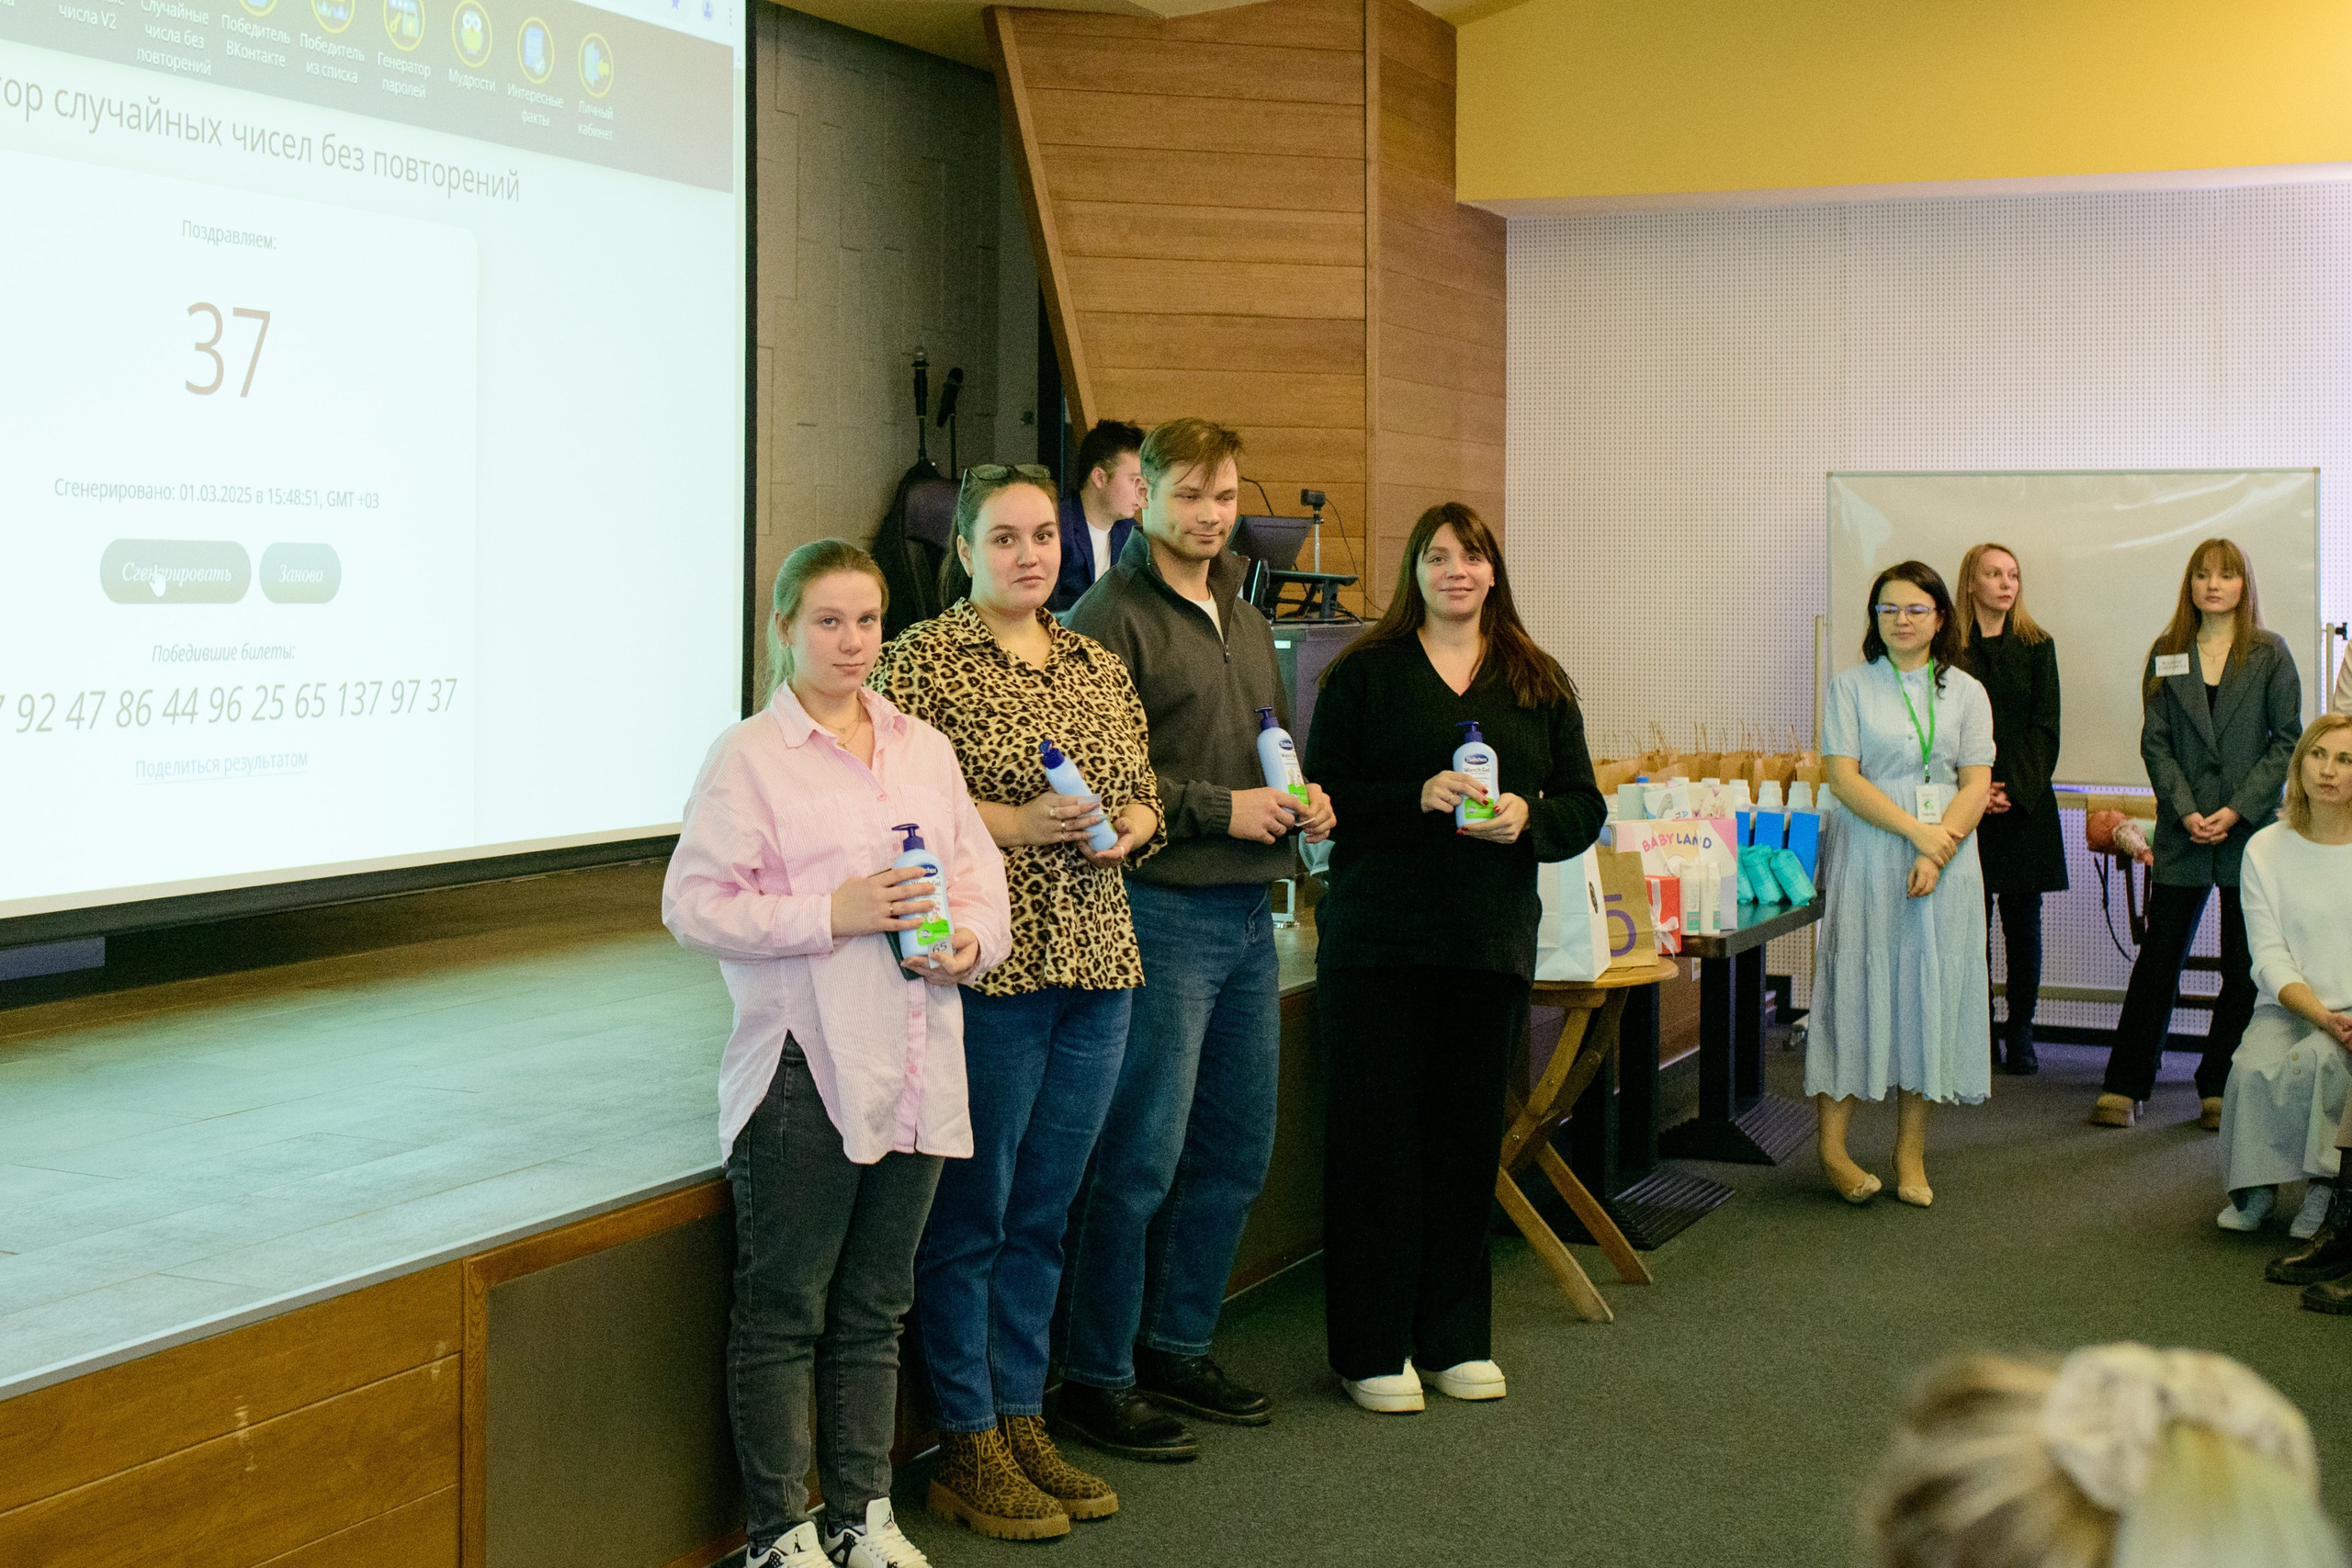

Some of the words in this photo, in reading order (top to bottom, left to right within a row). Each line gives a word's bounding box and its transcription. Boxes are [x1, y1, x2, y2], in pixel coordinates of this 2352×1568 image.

[59, 5, 98, 26] числа
[100, 10, 117, 29] V2
[221, 14, 291, 45] Победитель
[144, 24, 181, 44] числа
[184, 30, 205, 50] без
[300, 33, 366, 62] Победитель
[137, 48, 211, 75] повторений
[226, 39, 287, 68] ВКонтакте
[377, 51, 432, 80] Генератор
[306, 62, 320, 75] из
[322, 64, 358, 85] списка
[448, 68, 496, 93] Мудрости
[382, 78, 426, 100] паролей
[507, 83, 565, 109] Интересные
[521, 109, 550, 128] факты
[578, 100, 615, 121] Личный
[54, 89, 223, 146] случайных
[232, 123, 312, 163] чисел
[322, 133, 365, 173] без
[374, 151, 520, 202] повторений
[578, 123, 615, 142] кабинет
[182, 220, 277, 250] Поздравляем:
[186, 301, 271, 398] 37
[54, 478, 176, 503] Сгенерировано:
[179, 484, 253, 505] 01.03.2025
[255, 491, 265, 505] в
[267, 488, 323, 510] 15:48:51,
[327, 491, 356, 508] GMT
[357, 492, 379, 509] +03
[278, 564, 323, 583] Заново
[152, 645, 237, 663] Победившие
[241, 643, 296, 662] билеты:
[16, 693, 55, 733] 92
[65, 691, 107, 730] 47
[116, 689, 153, 728] 86
[162, 687, 198, 726] 44
[208, 685, 243, 723] 96
[252, 683, 286, 721] 25
[295, 682, 327, 718] 65
[337, 681, 383, 716] 137
[390, 679, 421, 714] 97
[427, 677, 458, 712] 37
[135, 759, 220, 781] Поделиться
[224, 750, 309, 777] результатом
